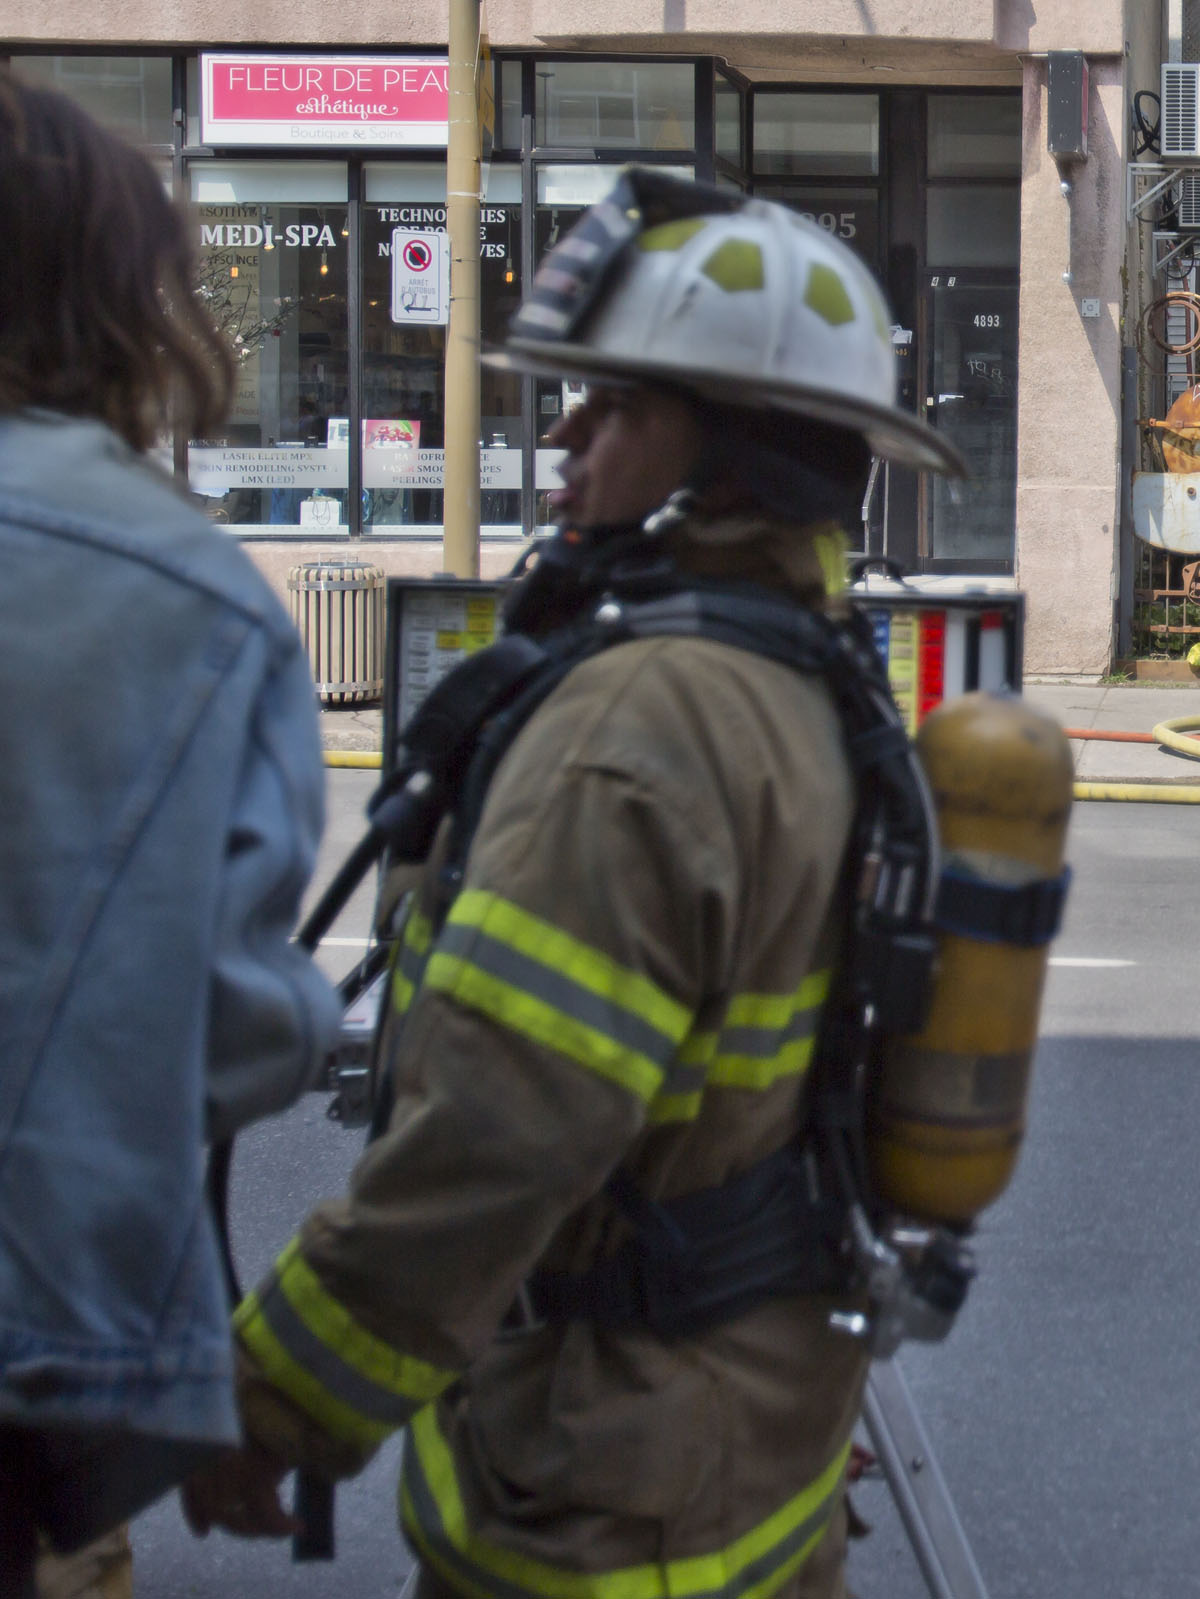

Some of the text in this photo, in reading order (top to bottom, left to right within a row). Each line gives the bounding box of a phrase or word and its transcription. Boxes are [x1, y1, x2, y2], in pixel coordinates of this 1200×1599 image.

[229, 67, 448, 93] FLEUR DE PEA
[296, 94, 399, 120] esthétique
[291, 127, 349, 142] Boutique
[370, 127, 405, 139] Soins
[378, 208, 506, 223] TECHNOIES
[200, 224, 337, 247] MEDI-SPA
[973, 315, 1000, 328] 4893
[225, 464, 294, 473] REMODELING
[242, 475, 264, 484] LMX
